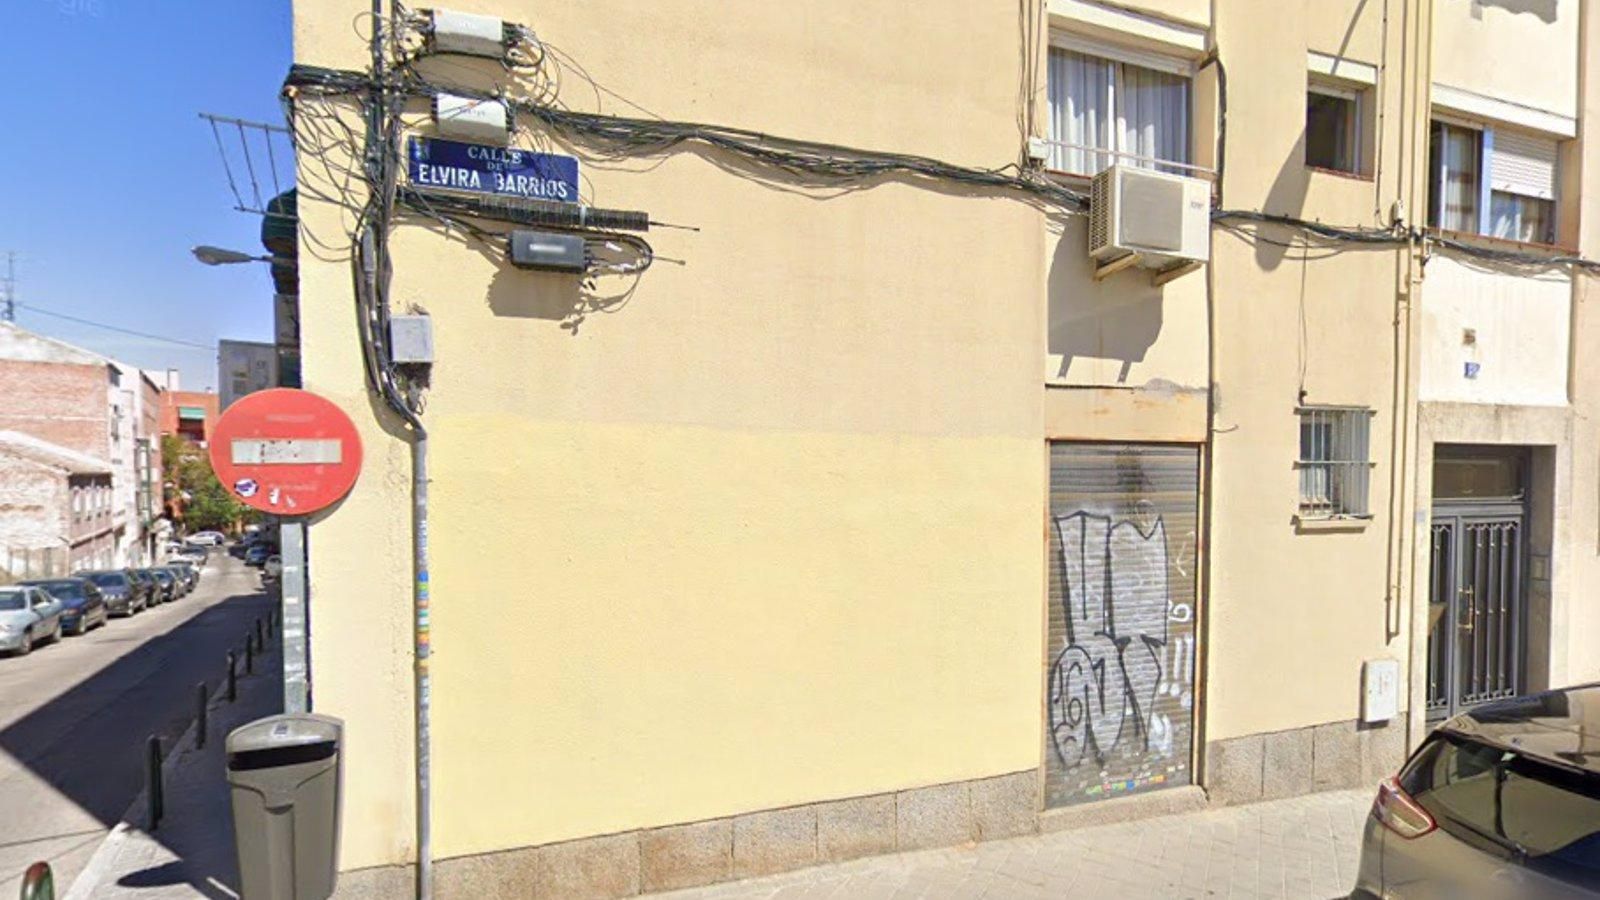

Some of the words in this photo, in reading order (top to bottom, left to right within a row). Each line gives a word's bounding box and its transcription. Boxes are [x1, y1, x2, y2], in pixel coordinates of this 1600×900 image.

[467, 146, 523, 164] CALLE
[487, 162, 503, 172] DE
[418, 164, 482, 189] ELVIRA
[495, 173, 569, 199] BARRIOS
